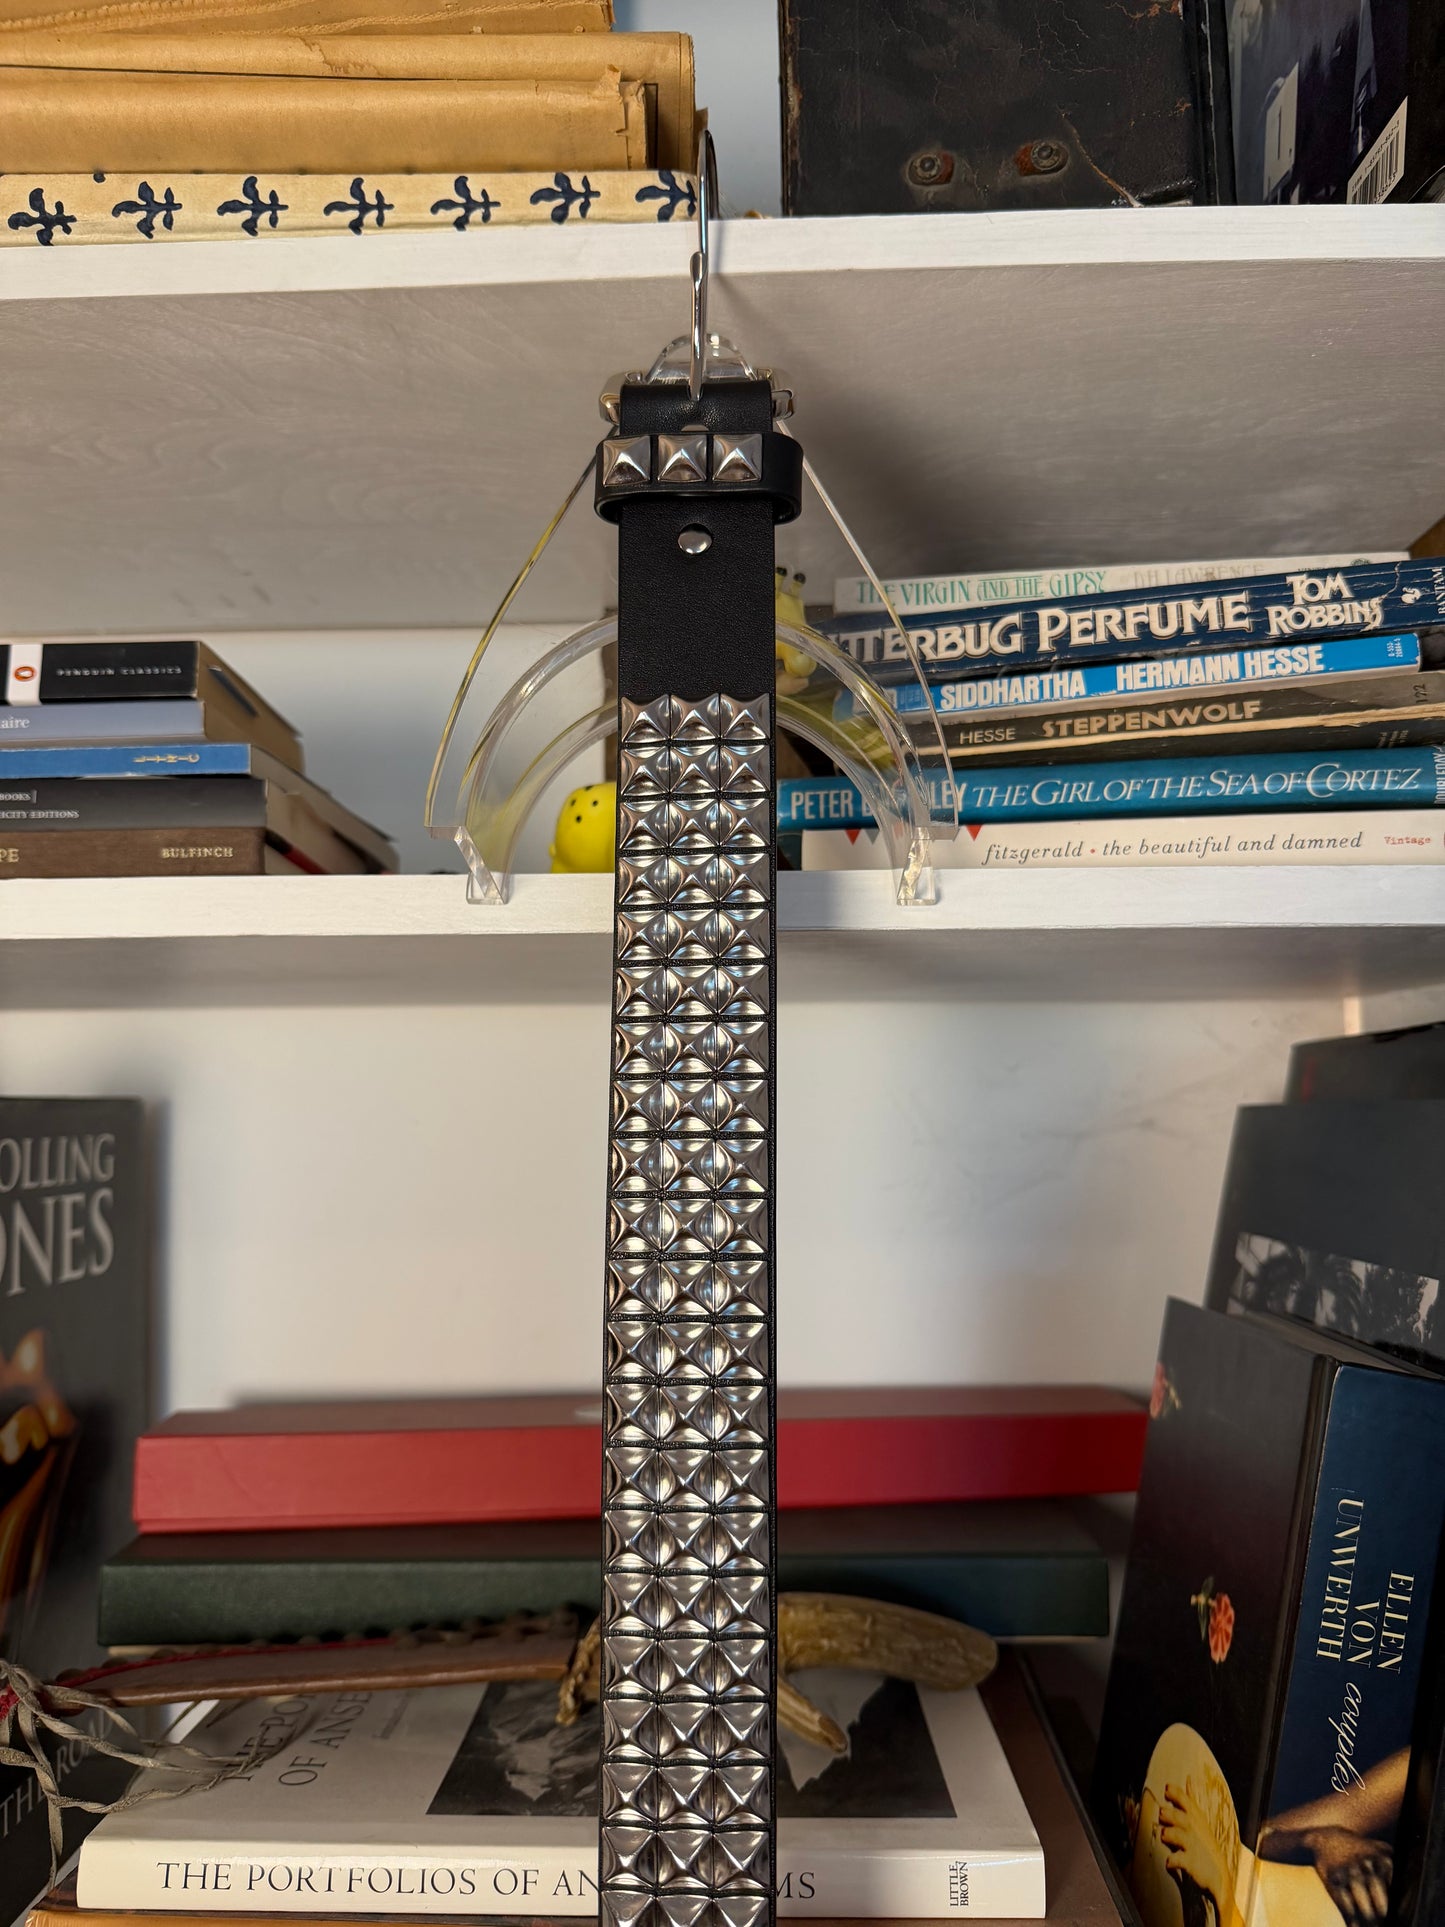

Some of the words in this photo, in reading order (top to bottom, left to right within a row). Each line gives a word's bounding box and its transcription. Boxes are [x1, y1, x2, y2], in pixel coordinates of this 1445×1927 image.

[856, 580, 896, 606] THE
[900, 578, 971, 606] VIRGIN
[1014, 574, 1043, 597] THE
[1049, 569, 1107, 595] GIPSY
[1285, 571, 1354, 605] TOM
[830, 611, 1027, 663] TTERBUG
[1037, 590, 1253, 650] PERFUME
[1264, 598, 1385, 636] ROBBINS
[56, 667, 115, 677] PENGUIN
[120, 665, 182, 676] CLASSICS
[940, 670, 1087, 710] SIDDHARTHA
[1115, 650, 1241, 692] HERMANN
[1243, 645, 1325, 679] HESSE
[0, 715, 30, 729] aire
[959, 728, 1016, 744] HESSE
[1041, 700, 1261, 738] STEPPENWOLF
[790, 790, 854, 821] PETER
[861, 781, 967, 818] BLEY
[972, 783, 1029, 808] THE
[1031, 777, 1100, 806] GIRL
[1102, 778, 1149, 802] OF
[1150, 775, 1205, 799] THE
[1206, 767, 1258, 798] SEA
[1263, 771, 1304, 795] OF
[1306, 762, 1422, 798] CORTEZ
[0, 811, 28, 819] ICITY
[161, 846, 234, 859] BULFINCH
[981, 842, 1083, 866] fitzgerald
[1102, 839, 1131, 857] the
[1138, 834, 1230, 859] beautiful
[1237, 834, 1276, 851] and
[1281, 831, 1363, 850] damned
[1383, 835, 1431, 847] Vintage
[1315, 1498, 1365, 1662] UNWERTH
[1346, 1598, 1381, 1669] VON
[1376, 1569, 1415, 1675] ELLEN
[1328, 1682, 1366, 1796] couples
[277, 1754, 328, 1786] OF
[156, 1861, 232, 1891] THE
[246, 1863, 476, 1895] PORTFOLIOS
[492, 1868, 540, 1896] OF
[959, 1862, 969, 1907] BROWN
